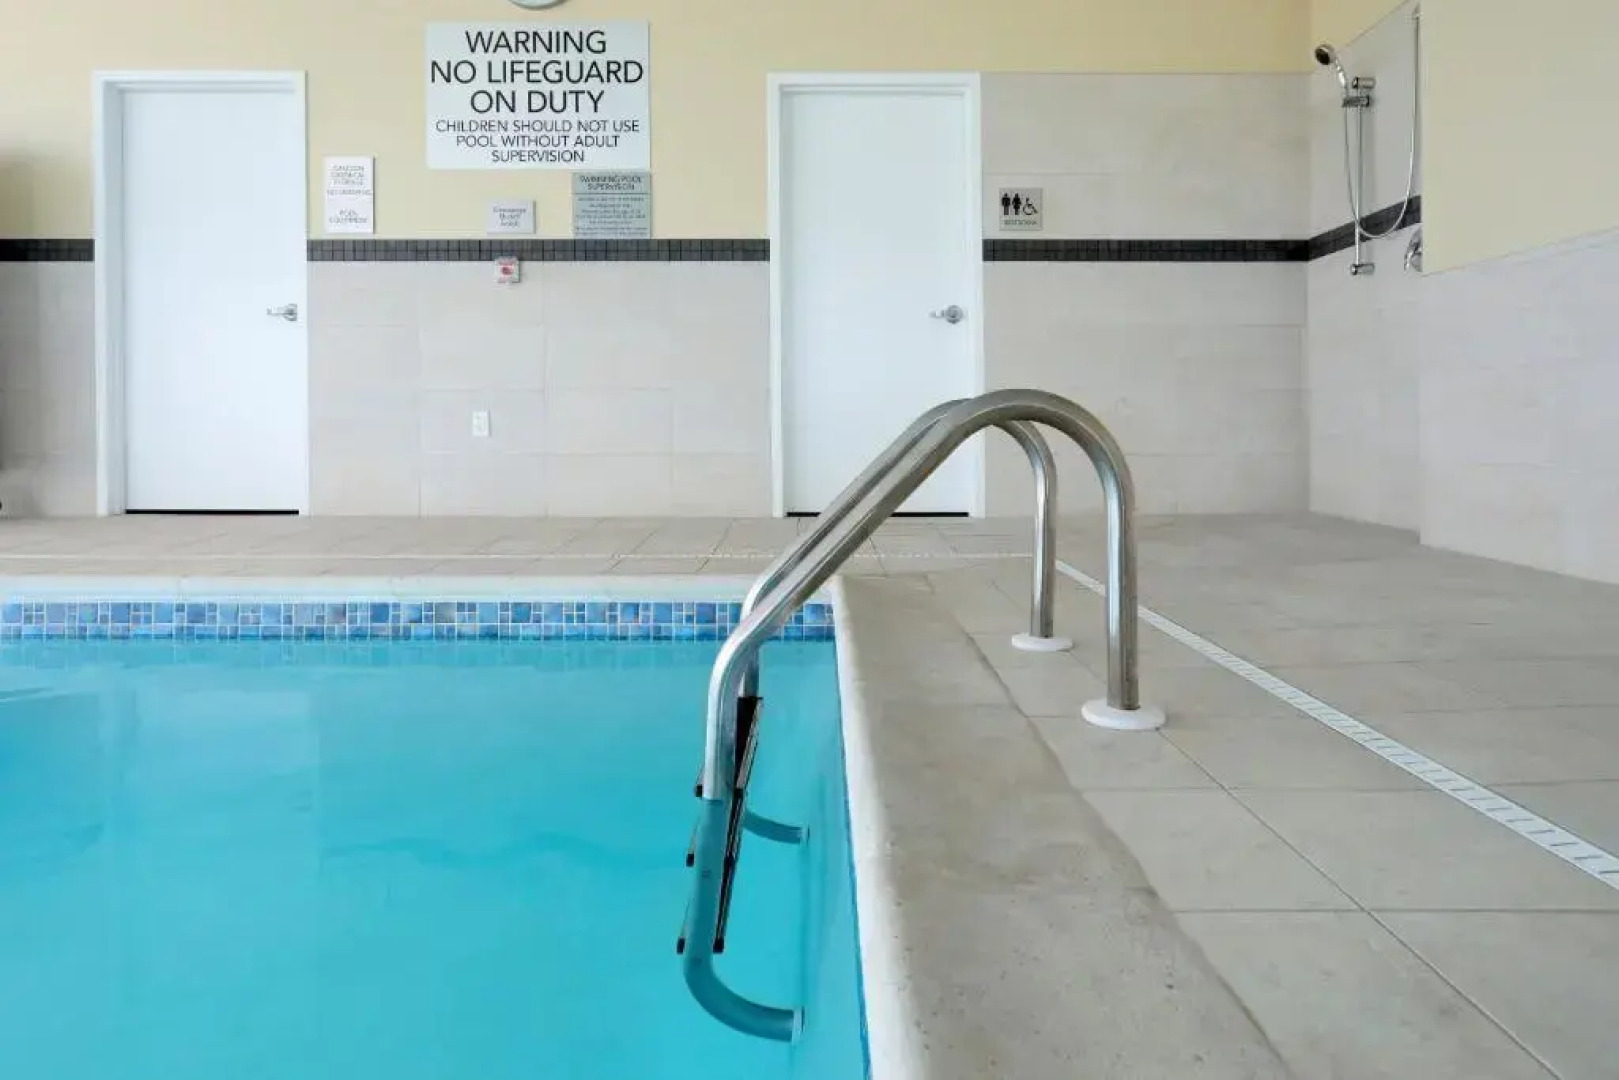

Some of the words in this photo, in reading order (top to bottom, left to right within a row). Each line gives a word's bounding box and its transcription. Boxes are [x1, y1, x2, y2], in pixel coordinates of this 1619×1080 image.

[465, 30, 607, 54] WARNING
[431, 60, 477, 84] NO
[487, 60, 644, 84] LIFEGUARD
[470, 89, 516, 114] ON
[527, 90, 605, 113] DUTY
[435, 119, 508, 133] CHILDREN
[513, 119, 572, 133] SHOULD
[577, 119, 608, 133] NOT
[612, 119, 640, 133] USE
[456, 134, 498, 148] POOL
[502, 134, 568, 148] WITHOUT
[573, 134, 621, 148] ADULT
[491, 149, 585, 163] SUPERVISION
